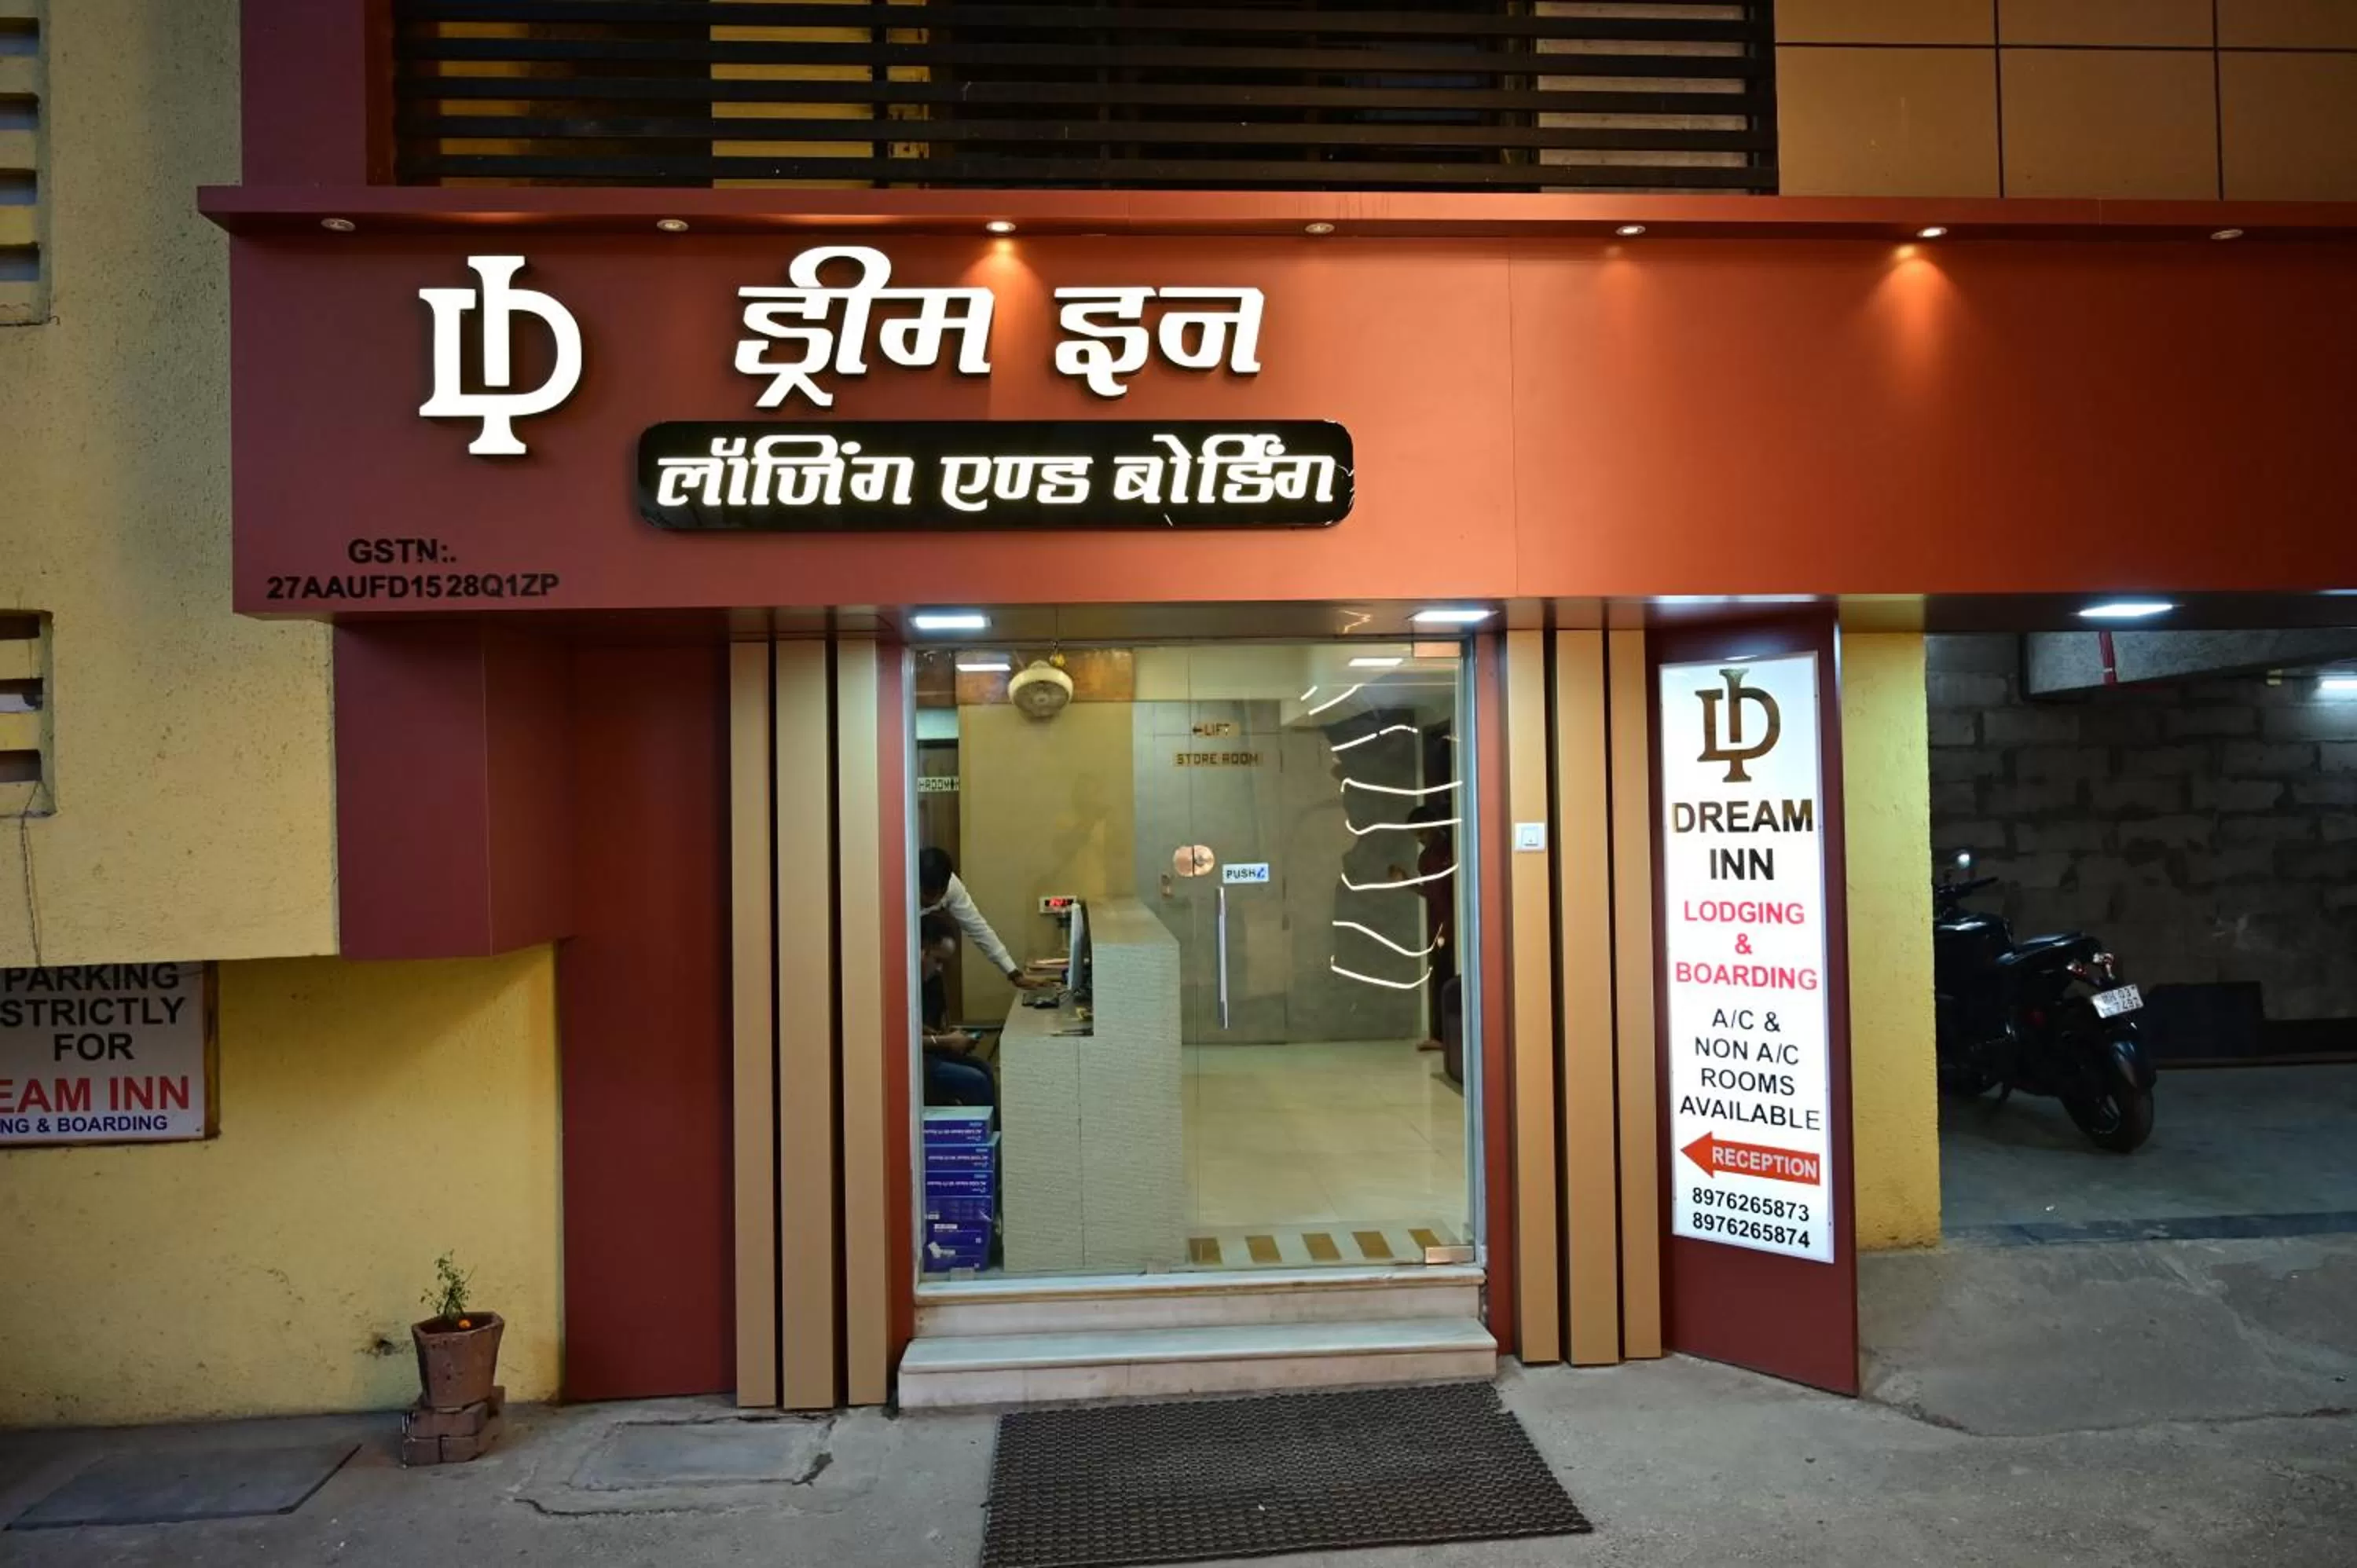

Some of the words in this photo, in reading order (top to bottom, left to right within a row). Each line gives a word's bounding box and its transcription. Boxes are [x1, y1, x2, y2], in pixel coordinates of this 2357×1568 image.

[735, 246, 995, 408] ड्रीम
[1054, 287, 1264, 396] इन
[657, 434, 915, 506] लॉजिंग
[941, 456, 1094, 511] एण्ड
[1113, 434, 1336, 504] बोर्डिंग
[1204, 724, 1230, 735] LIFT
[1177, 753, 1218, 764] STORE
[1222, 753, 1259, 764] ROOM
[1672, 799, 1813, 833] DREAM
[1226, 868, 1256, 879] PUSH
[1710, 848, 1774, 880] INN
[1684, 900, 1805, 924] LODGING
[1735, 933, 1752, 954] &
[5, 962, 179, 993] PARKING
[1676, 962, 1817, 990] BOARDING
[0, 996, 185, 1027] STRICTLY
[1712, 1009, 1754, 1030] A/C
[1764, 1012, 1780, 1032] &
[53, 1032, 135, 1061] FOR
[1695, 1037, 1748, 1060] NON
[1756, 1042, 1799, 1065] A/C
[109, 1075, 189, 1111] INN
[1701, 1068, 1795, 1096] ROOMS
[37, 1117, 50, 1133] &
[57, 1116, 167, 1132] BOARDING
[1680, 1096, 1820, 1130] AVAILABLE
[1711, 1146, 1817, 1178] RECEPTION
[1692, 1187, 1810, 1222] 8976265873
[1692, 1213, 1811, 1247] 8976265874
